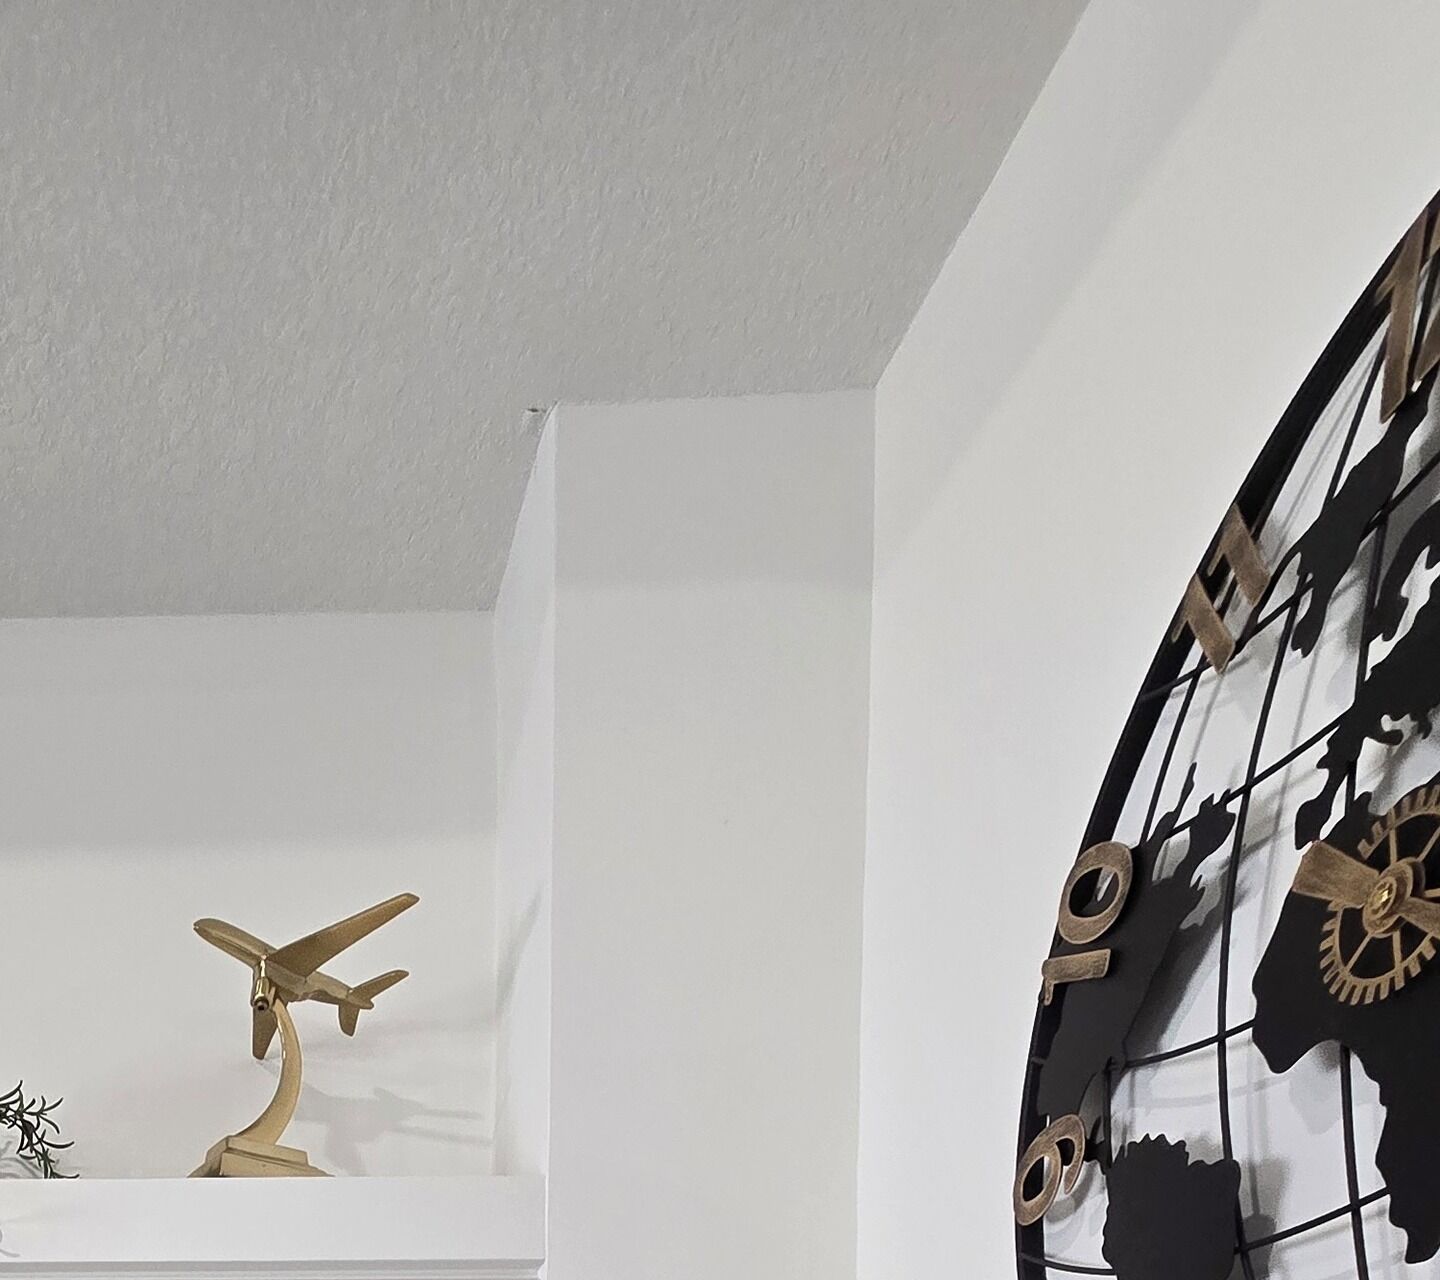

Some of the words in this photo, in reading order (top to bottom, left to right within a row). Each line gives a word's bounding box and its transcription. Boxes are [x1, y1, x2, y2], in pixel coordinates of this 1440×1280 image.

[1172, 502, 1271, 675] 11
[1041, 840, 1133, 1006] 10
[1013, 1113, 1085, 1225] 9
